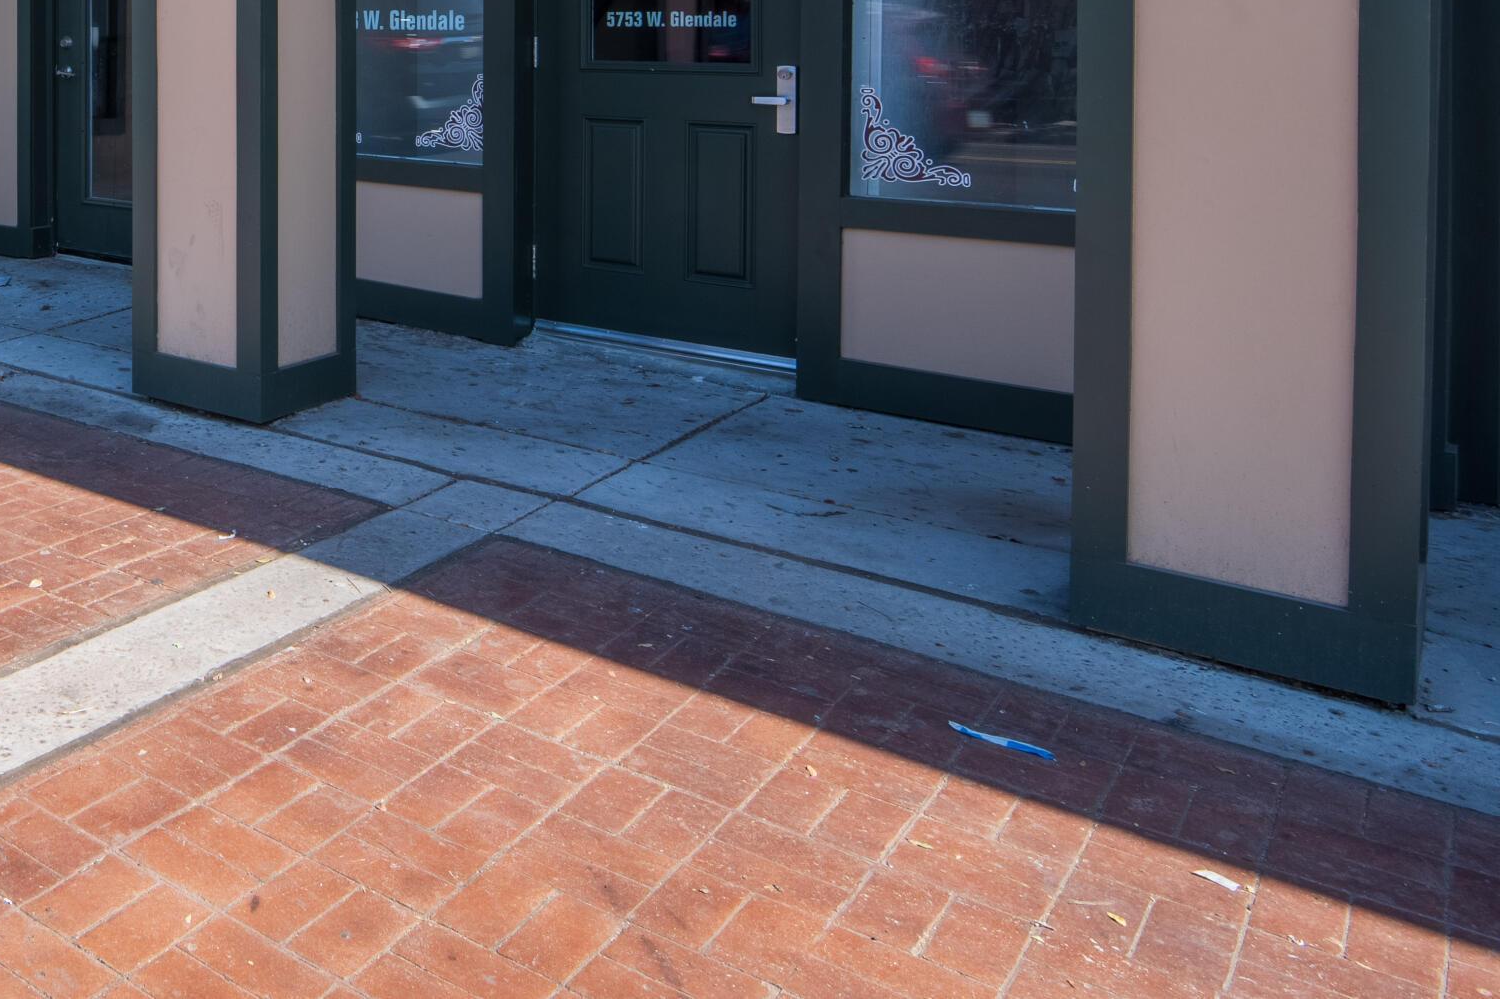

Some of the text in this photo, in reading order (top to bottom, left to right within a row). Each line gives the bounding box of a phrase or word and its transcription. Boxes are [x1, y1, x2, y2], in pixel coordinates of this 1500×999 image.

[363, 9, 384, 31] W.
[389, 9, 465, 31] Glendale
[606, 10, 737, 28] 5753 W. Glendale
